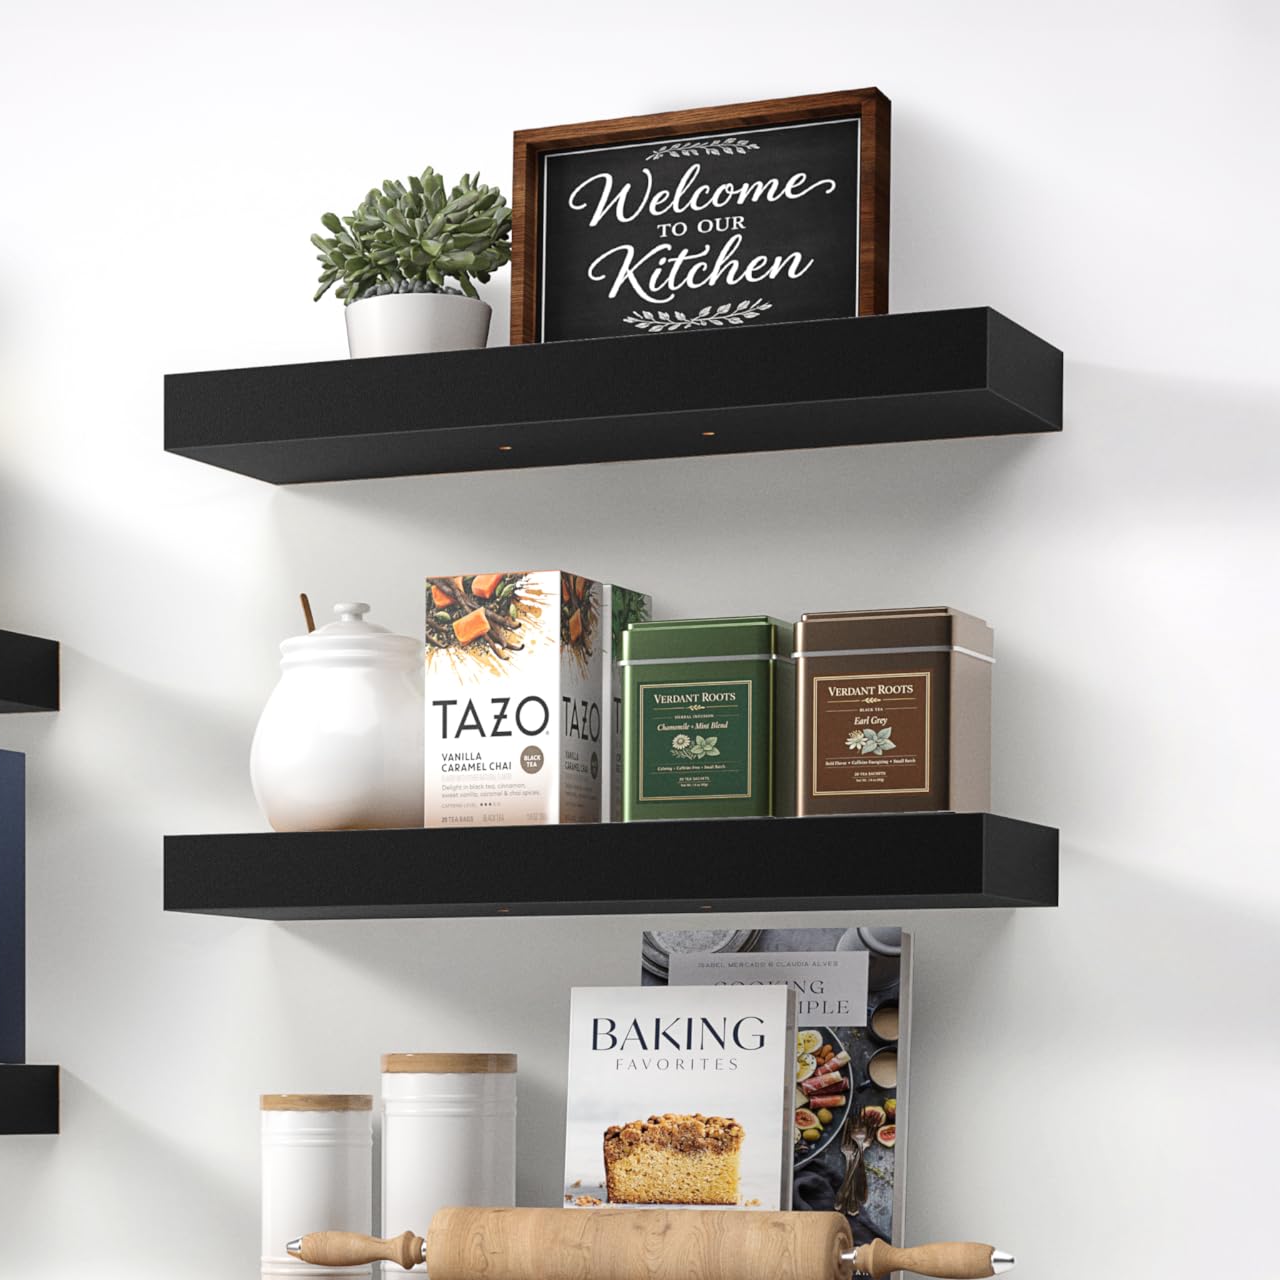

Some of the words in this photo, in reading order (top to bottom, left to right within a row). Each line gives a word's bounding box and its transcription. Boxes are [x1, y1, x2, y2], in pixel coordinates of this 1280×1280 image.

[568, 164, 836, 228] Welcome
[657, 221, 688, 238] TO
[697, 215, 747, 233] OUR
[588, 234, 815, 304] Kitchen
[828, 686, 876, 697] VERDANT
[877, 684, 914, 695] ROOTS
[653, 693, 700, 704] VERDANT
[701, 692, 736, 702] ROOTS
[432, 695, 550, 739] TAZO
[562, 696, 601, 742] TAZO
[853, 716, 870, 726] Earl
[870, 716, 888, 726] Grey
[441, 751, 482, 762] VANILLA
[523, 754, 542, 762] BLACK
[441, 762, 487, 773] CARAMEL
[488, 761, 512, 771] CHAI
[591, 1015, 765, 1051] BAKING
[615, 1058, 738, 1071] FAVORITES
